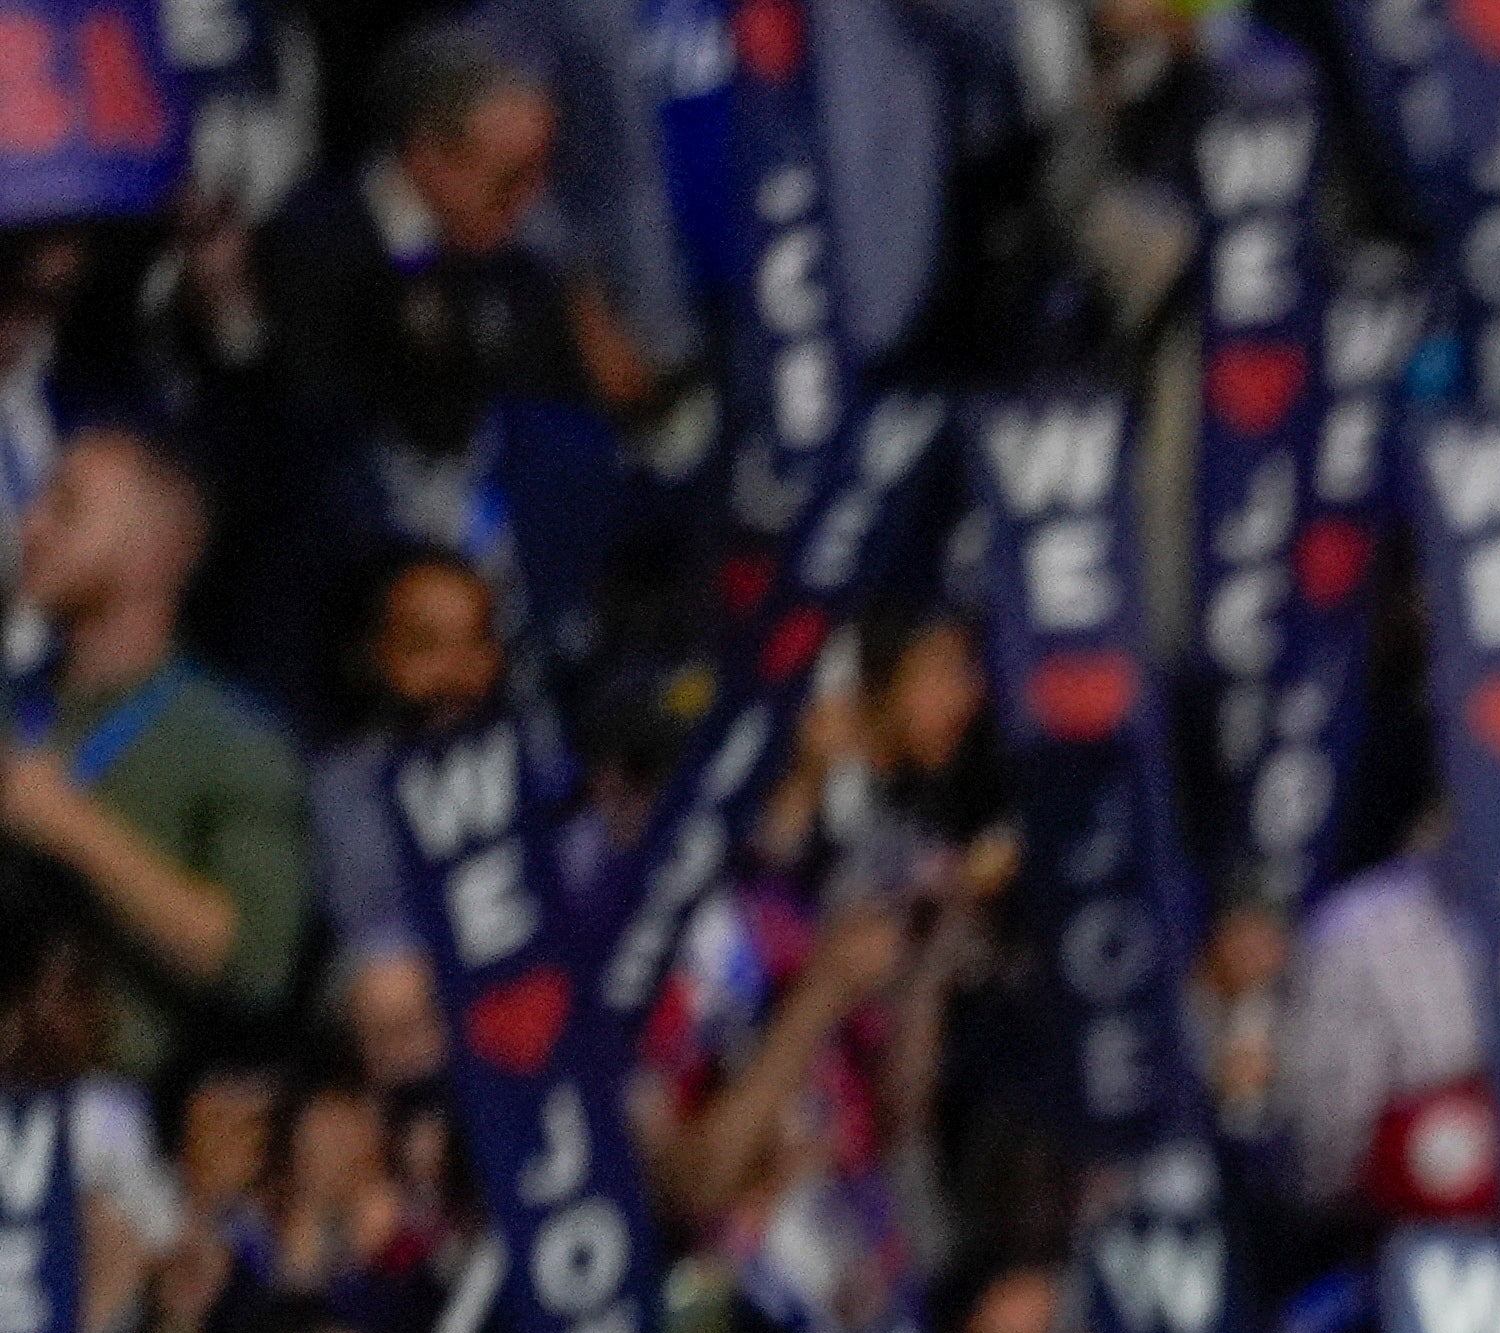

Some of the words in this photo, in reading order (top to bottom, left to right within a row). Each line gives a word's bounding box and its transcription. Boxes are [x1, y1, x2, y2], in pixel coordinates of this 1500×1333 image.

[1200, 115, 1312, 325] WE
[985, 400, 1122, 630] WE
[400, 725, 540, 968] WE
